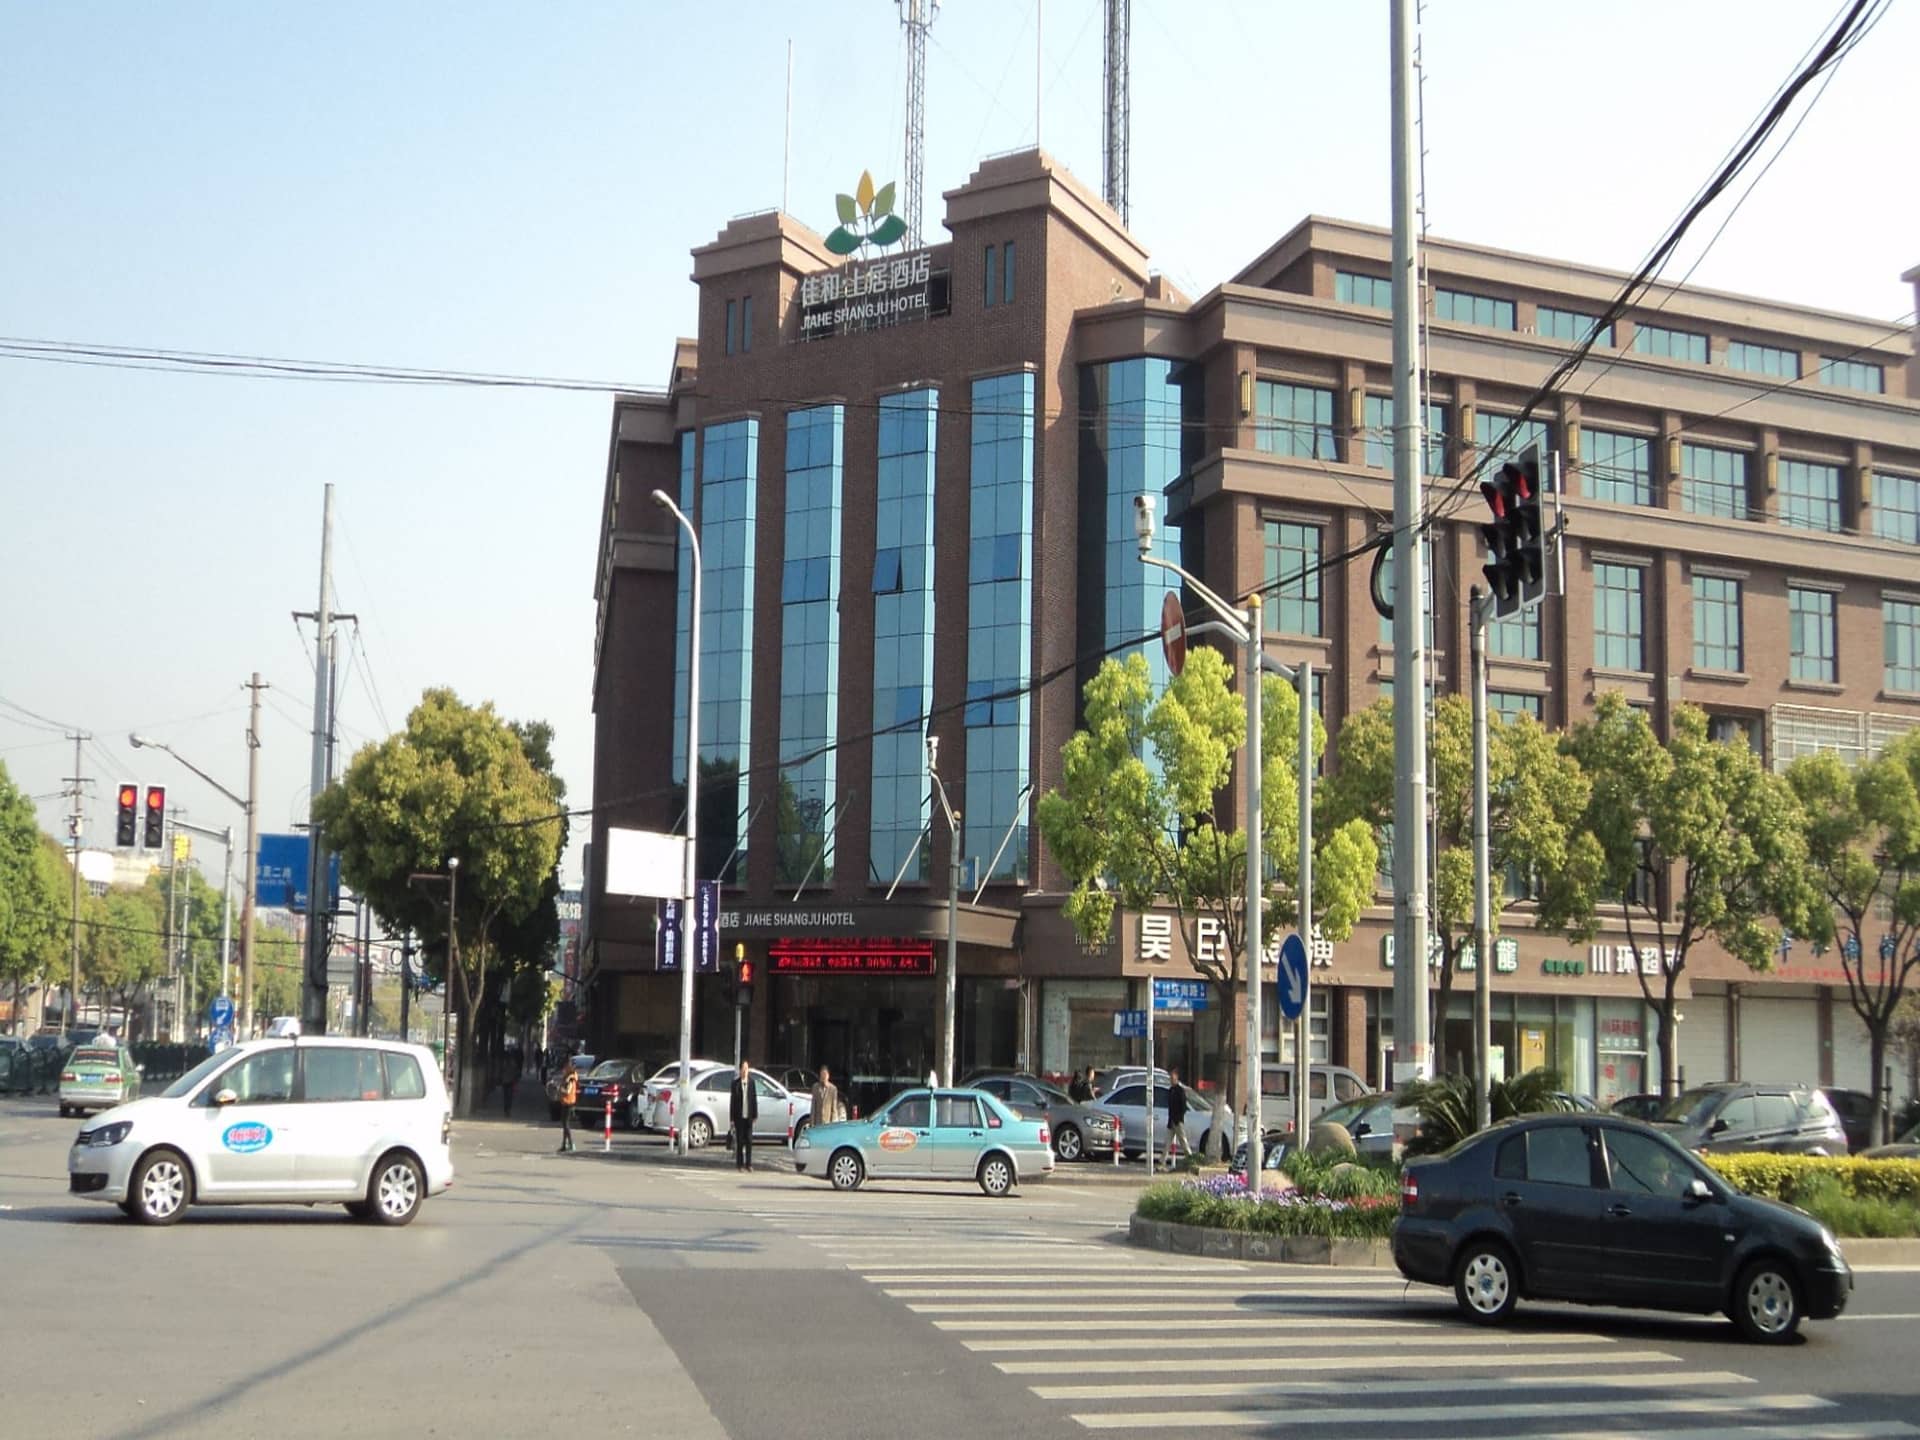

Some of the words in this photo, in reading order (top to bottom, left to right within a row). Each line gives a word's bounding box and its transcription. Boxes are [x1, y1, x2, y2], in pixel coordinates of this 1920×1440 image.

[801, 312, 833, 330] JIAHE
[834, 300, 889, 323] SHANGJU
[890, 293, 929, 313] HOTEL
[744, 911, 772, 927] JIAHE
[774, 911, 822, 927] SHANGJU
[822, 911, 856, 926] HOTEL
